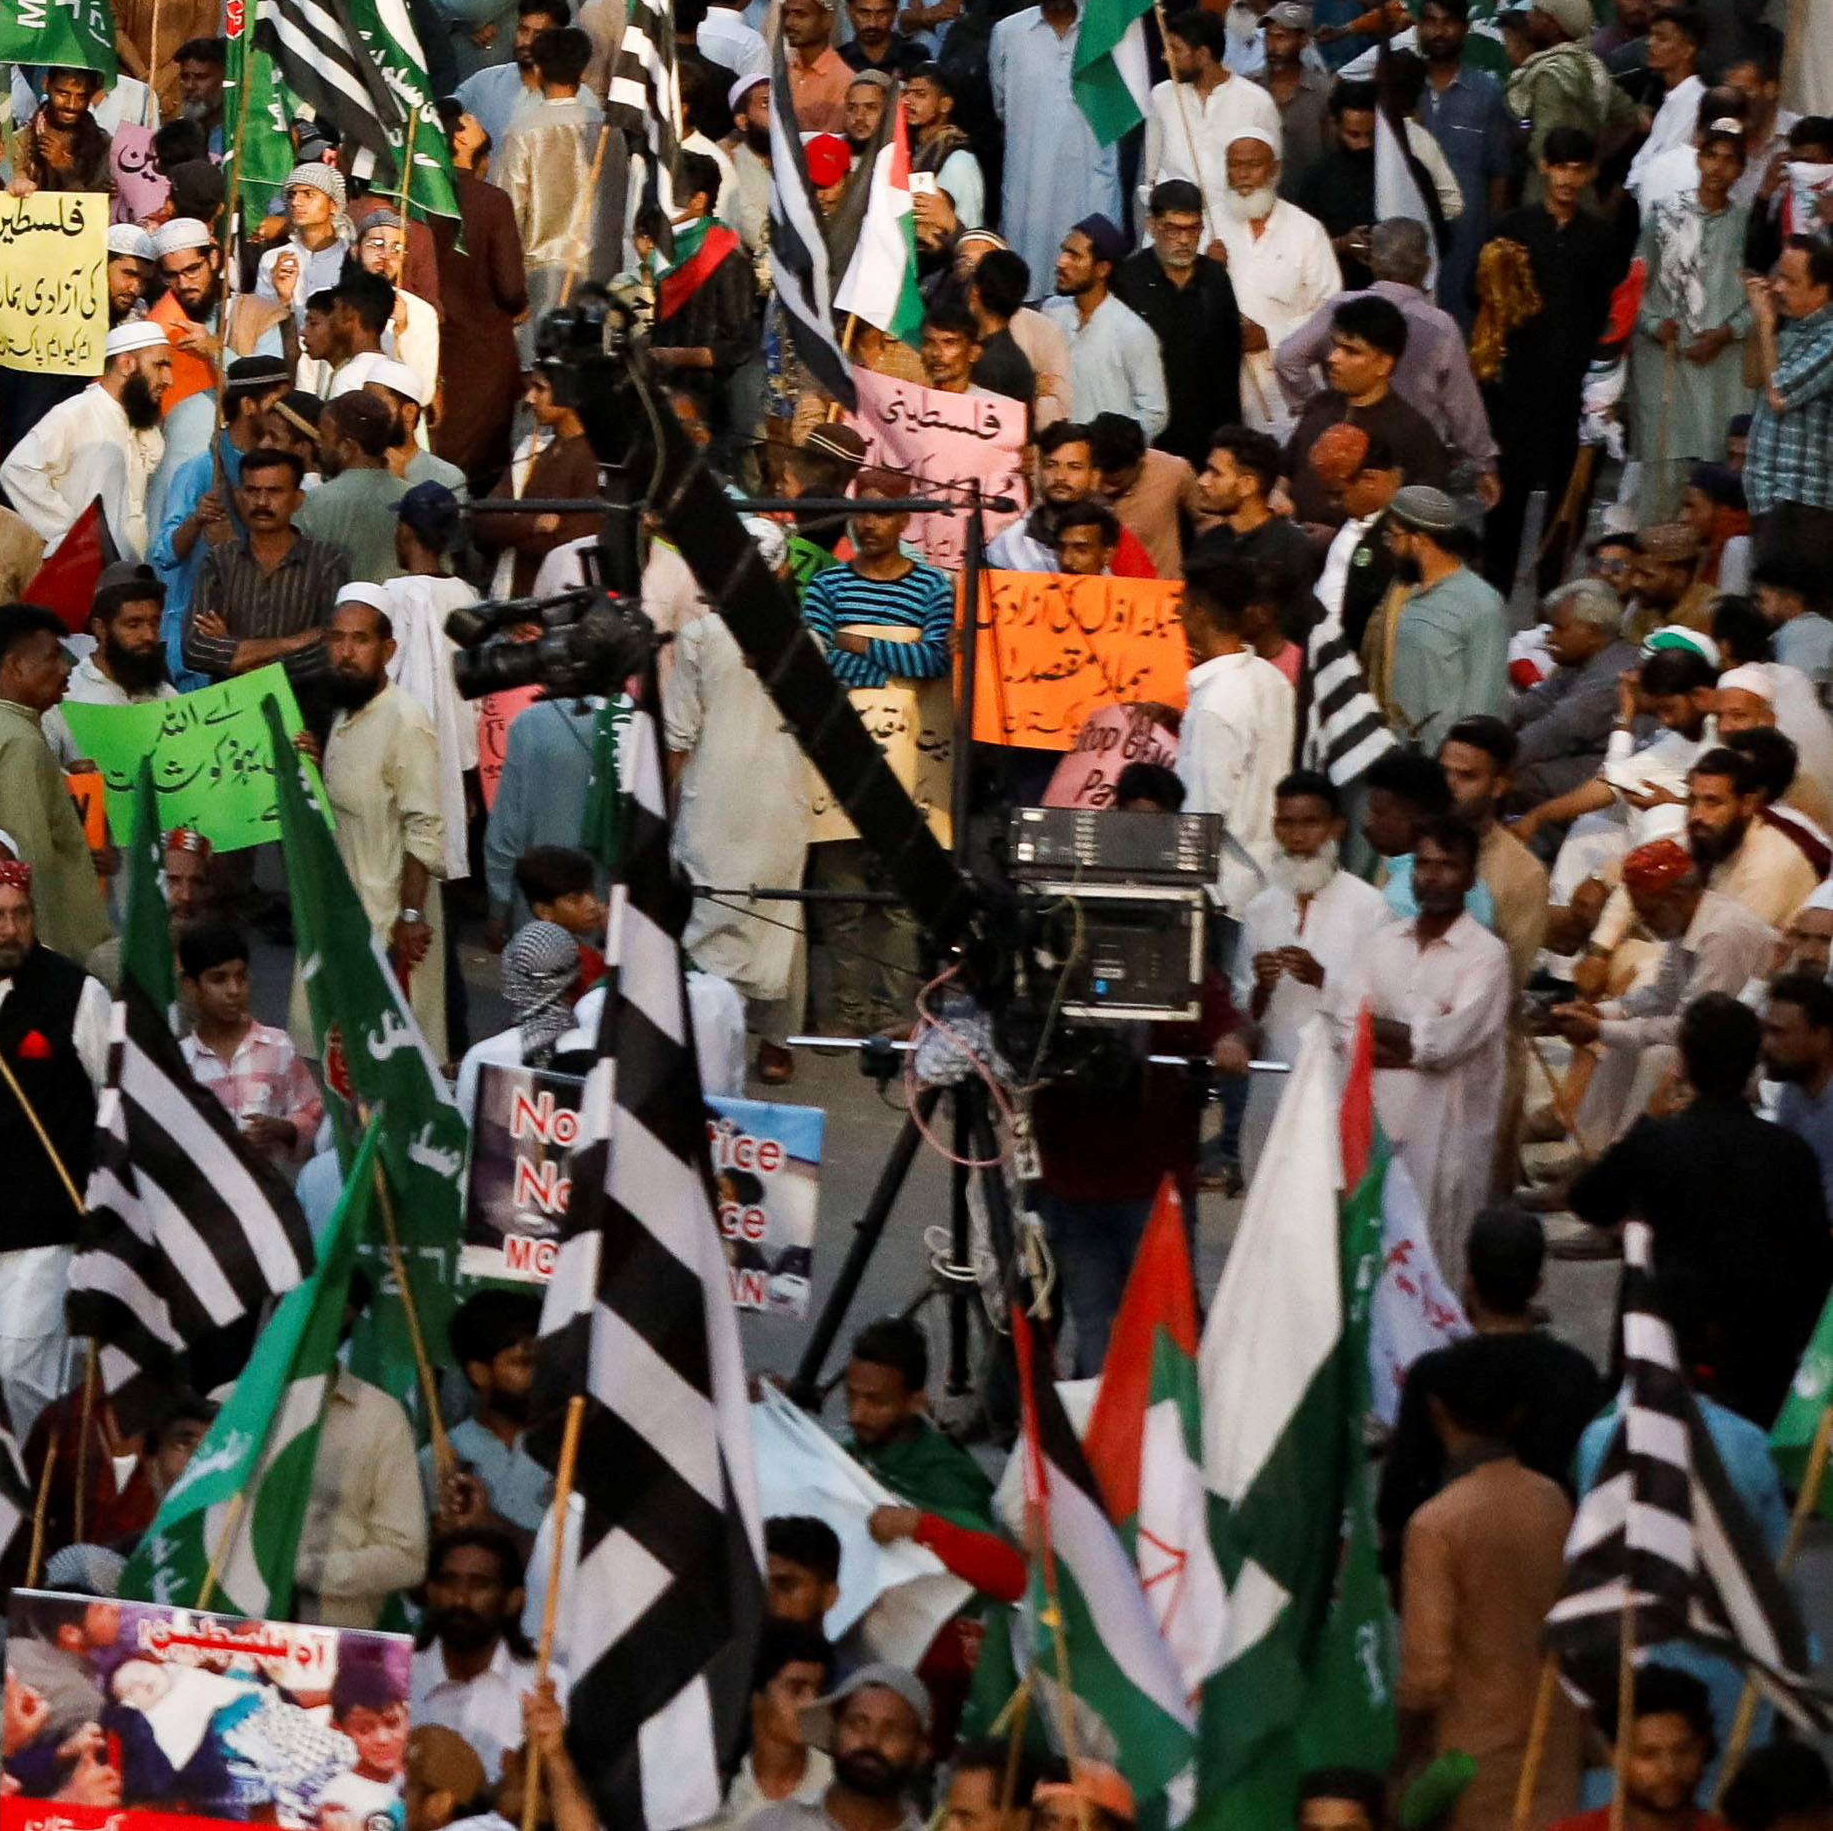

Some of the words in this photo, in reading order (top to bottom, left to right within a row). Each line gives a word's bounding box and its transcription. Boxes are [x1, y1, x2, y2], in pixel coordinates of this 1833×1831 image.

[24, 267, 85, 317] آزادی
[79, 258, 104, 320] کی
[508, 1086, 582, 1146] No
